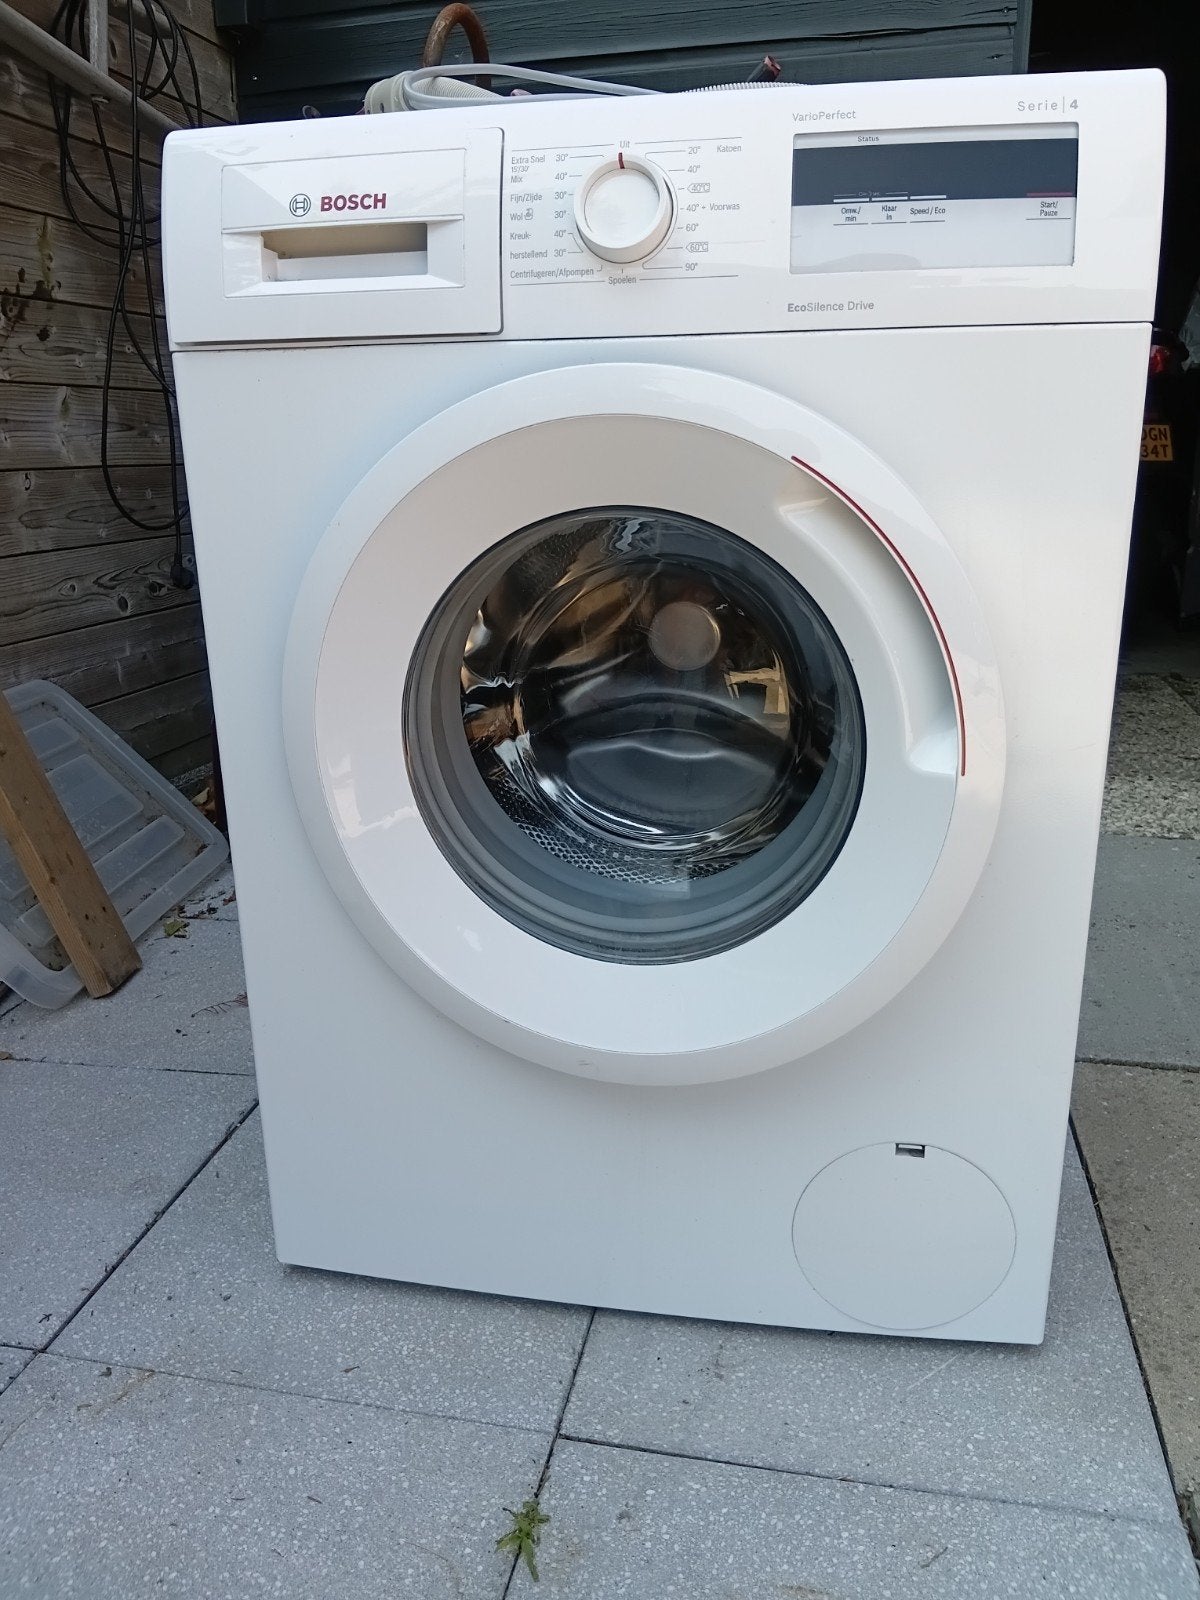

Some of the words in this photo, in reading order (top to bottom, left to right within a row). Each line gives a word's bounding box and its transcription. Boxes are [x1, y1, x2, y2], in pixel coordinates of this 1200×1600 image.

[1017, 100, 1058, 111] Serie
[1070, 99, 1079, 110] 4
[792, 110, 856, 121] VarioPerfect
[857, 135, 880, 143] Status
[619, 140, 630, 149] Uit
[716, 145, 742, 153] Katoen
[688, 146, 701, 155] 20°
[511, 156, 529, 165] Extra
[530, 154, 546, 163] Snel
[555, 153, 569, 162] 30°
[687, 164, 701, 174] 40°
[510, 176, 523, 184] Mix
[554, 172, 568, 181] 40°
[510, 193, 543, 204] Fijn/Zijde
[554, 191, 567, 200] 30°
[320, 193, 387, 212] BOSCH
[686, 203, 700, 212] 40°
[709, 202, 741, 211] Voorwas
[1040, 200, 1059, 209] Start/
[881, 204, 897, 212] Klaar
[910, 207, 930, 216] Speed
[934, 206, 946, 214] Eco
[510, 213, 524, 221] Wol
[554, 210, 567, 219] 30°
[1040, 209, 1058, 217] Pauze
[685, 223, 699, 232] 60°
[510, 232, 531, 240] Kreuk-
[554, 229, 567, 238] 40°
[510, 250, 548, 260] herstellend
[554, 249, 567, 258] 30°
[685, 262, 698, 271] 90°
[510, 267, 594, 279] Centrifugeren/Afpompen
[608, 275, 637, 285] Spoelen
[787, 302, 845, 312] EcoSilence
[847, 300, 875, 311] Drive
